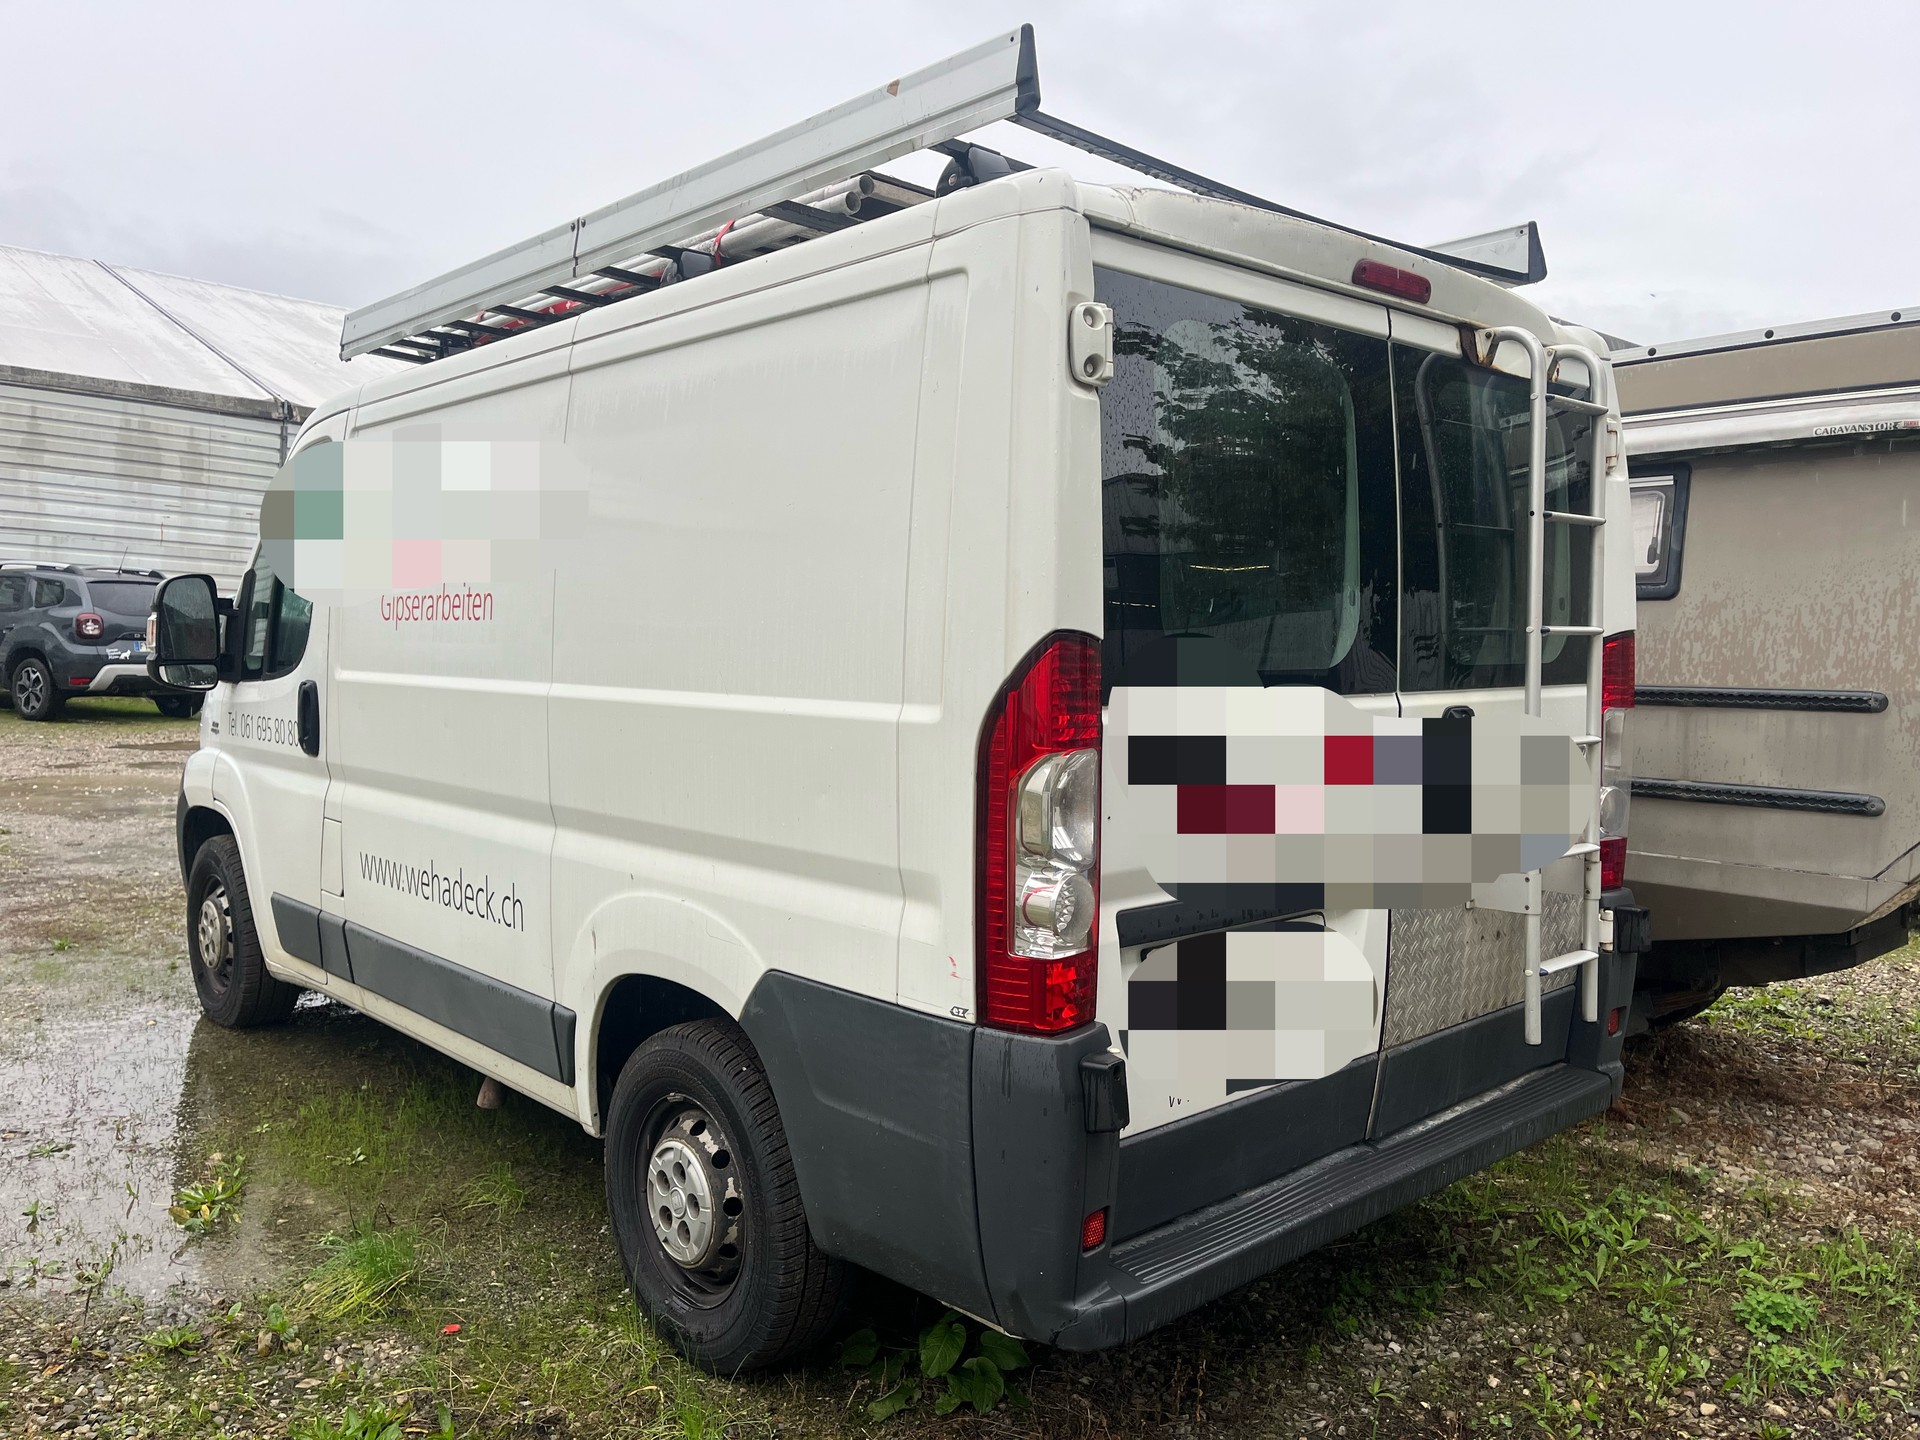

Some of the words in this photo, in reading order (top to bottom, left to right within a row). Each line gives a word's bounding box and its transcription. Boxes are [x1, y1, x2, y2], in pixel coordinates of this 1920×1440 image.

[381, 582, 493, 631] Gipserarbeiten
[228, 711, 239, 737] Tel.
[240, 713, 254, 739] 061
[256, 715, 273, 742] 695
[274, 718, 286, 745] 80
[359, 851, 524, 932] www.wehadeck.ch
